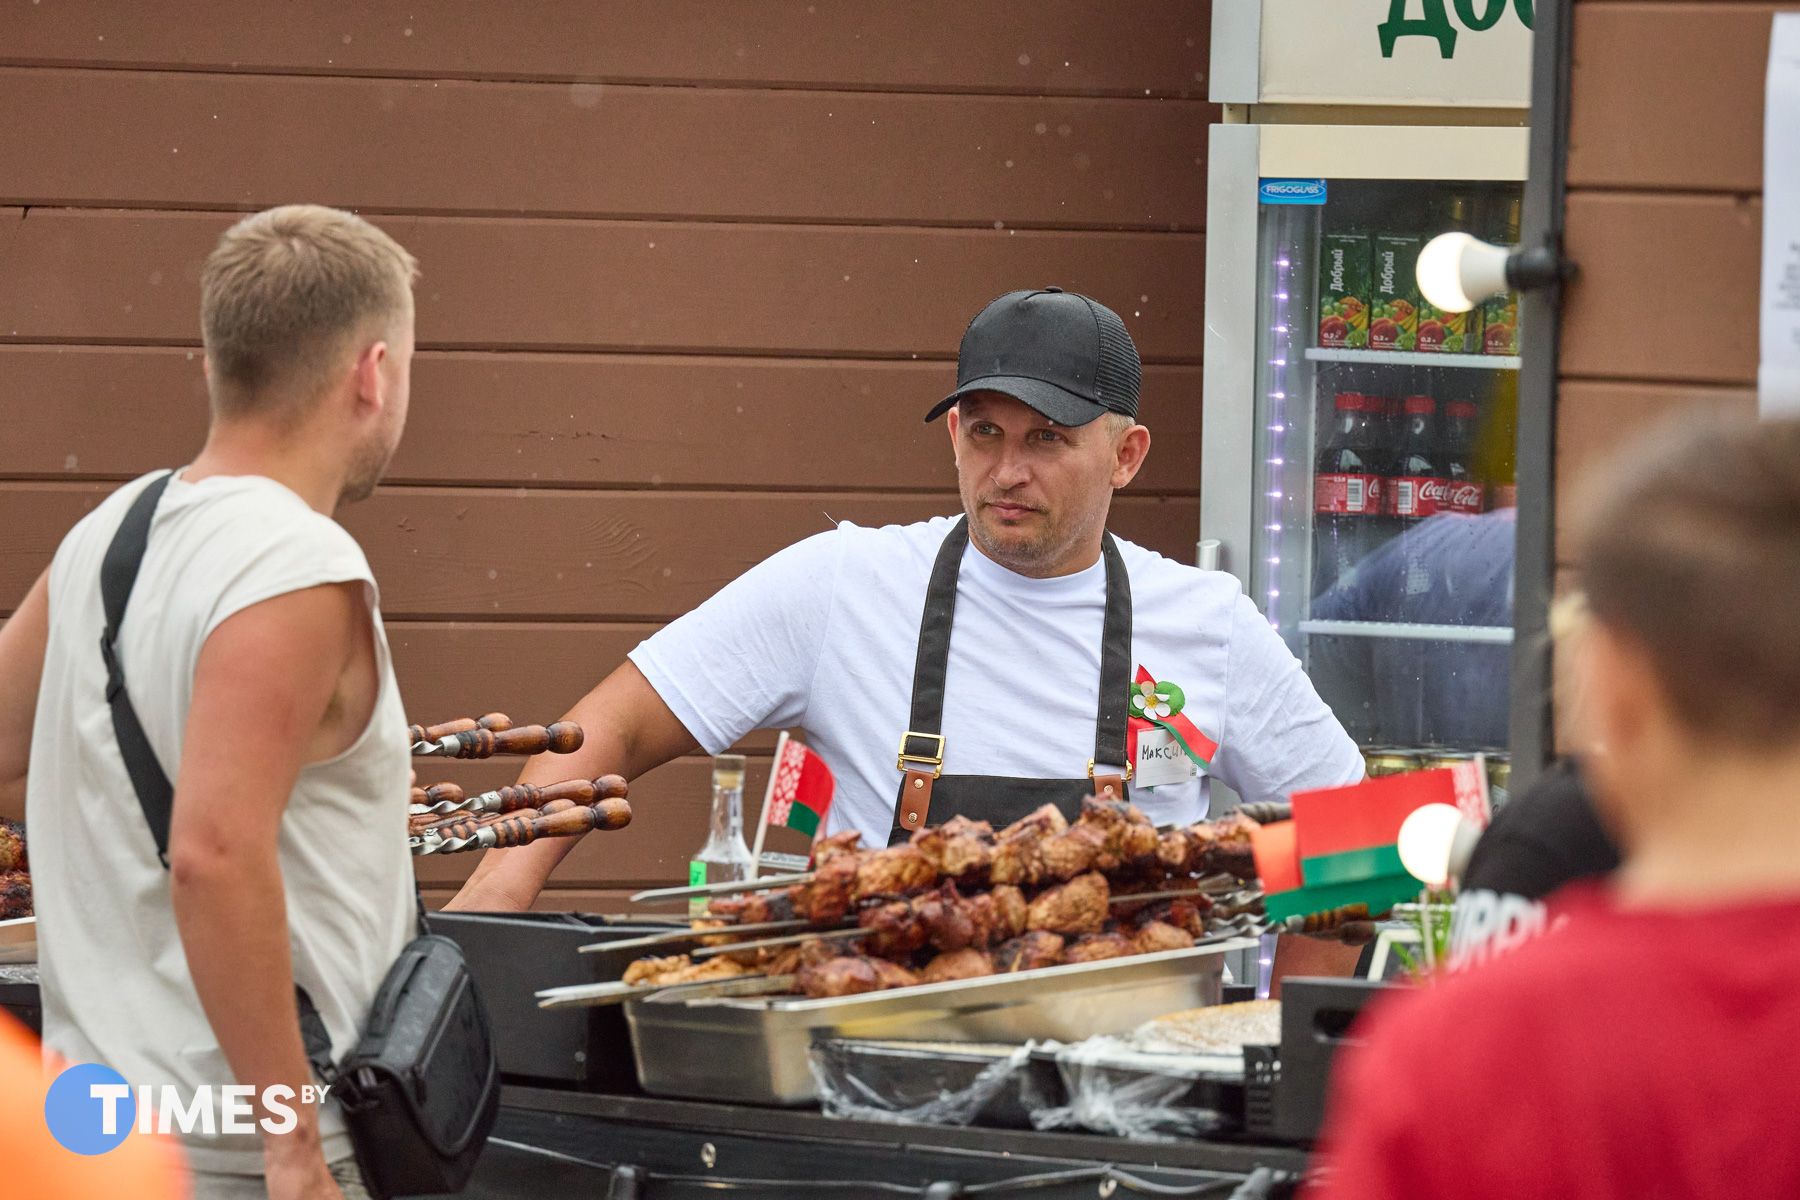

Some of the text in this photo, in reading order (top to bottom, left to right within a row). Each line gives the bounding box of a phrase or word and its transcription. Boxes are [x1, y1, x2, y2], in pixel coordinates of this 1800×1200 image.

[1265, 185, 1319, 194] FRIGOGLASS
[1330, 249, 1344, 292] Добрый
[1380, 251, 1395, 294] Добрый
